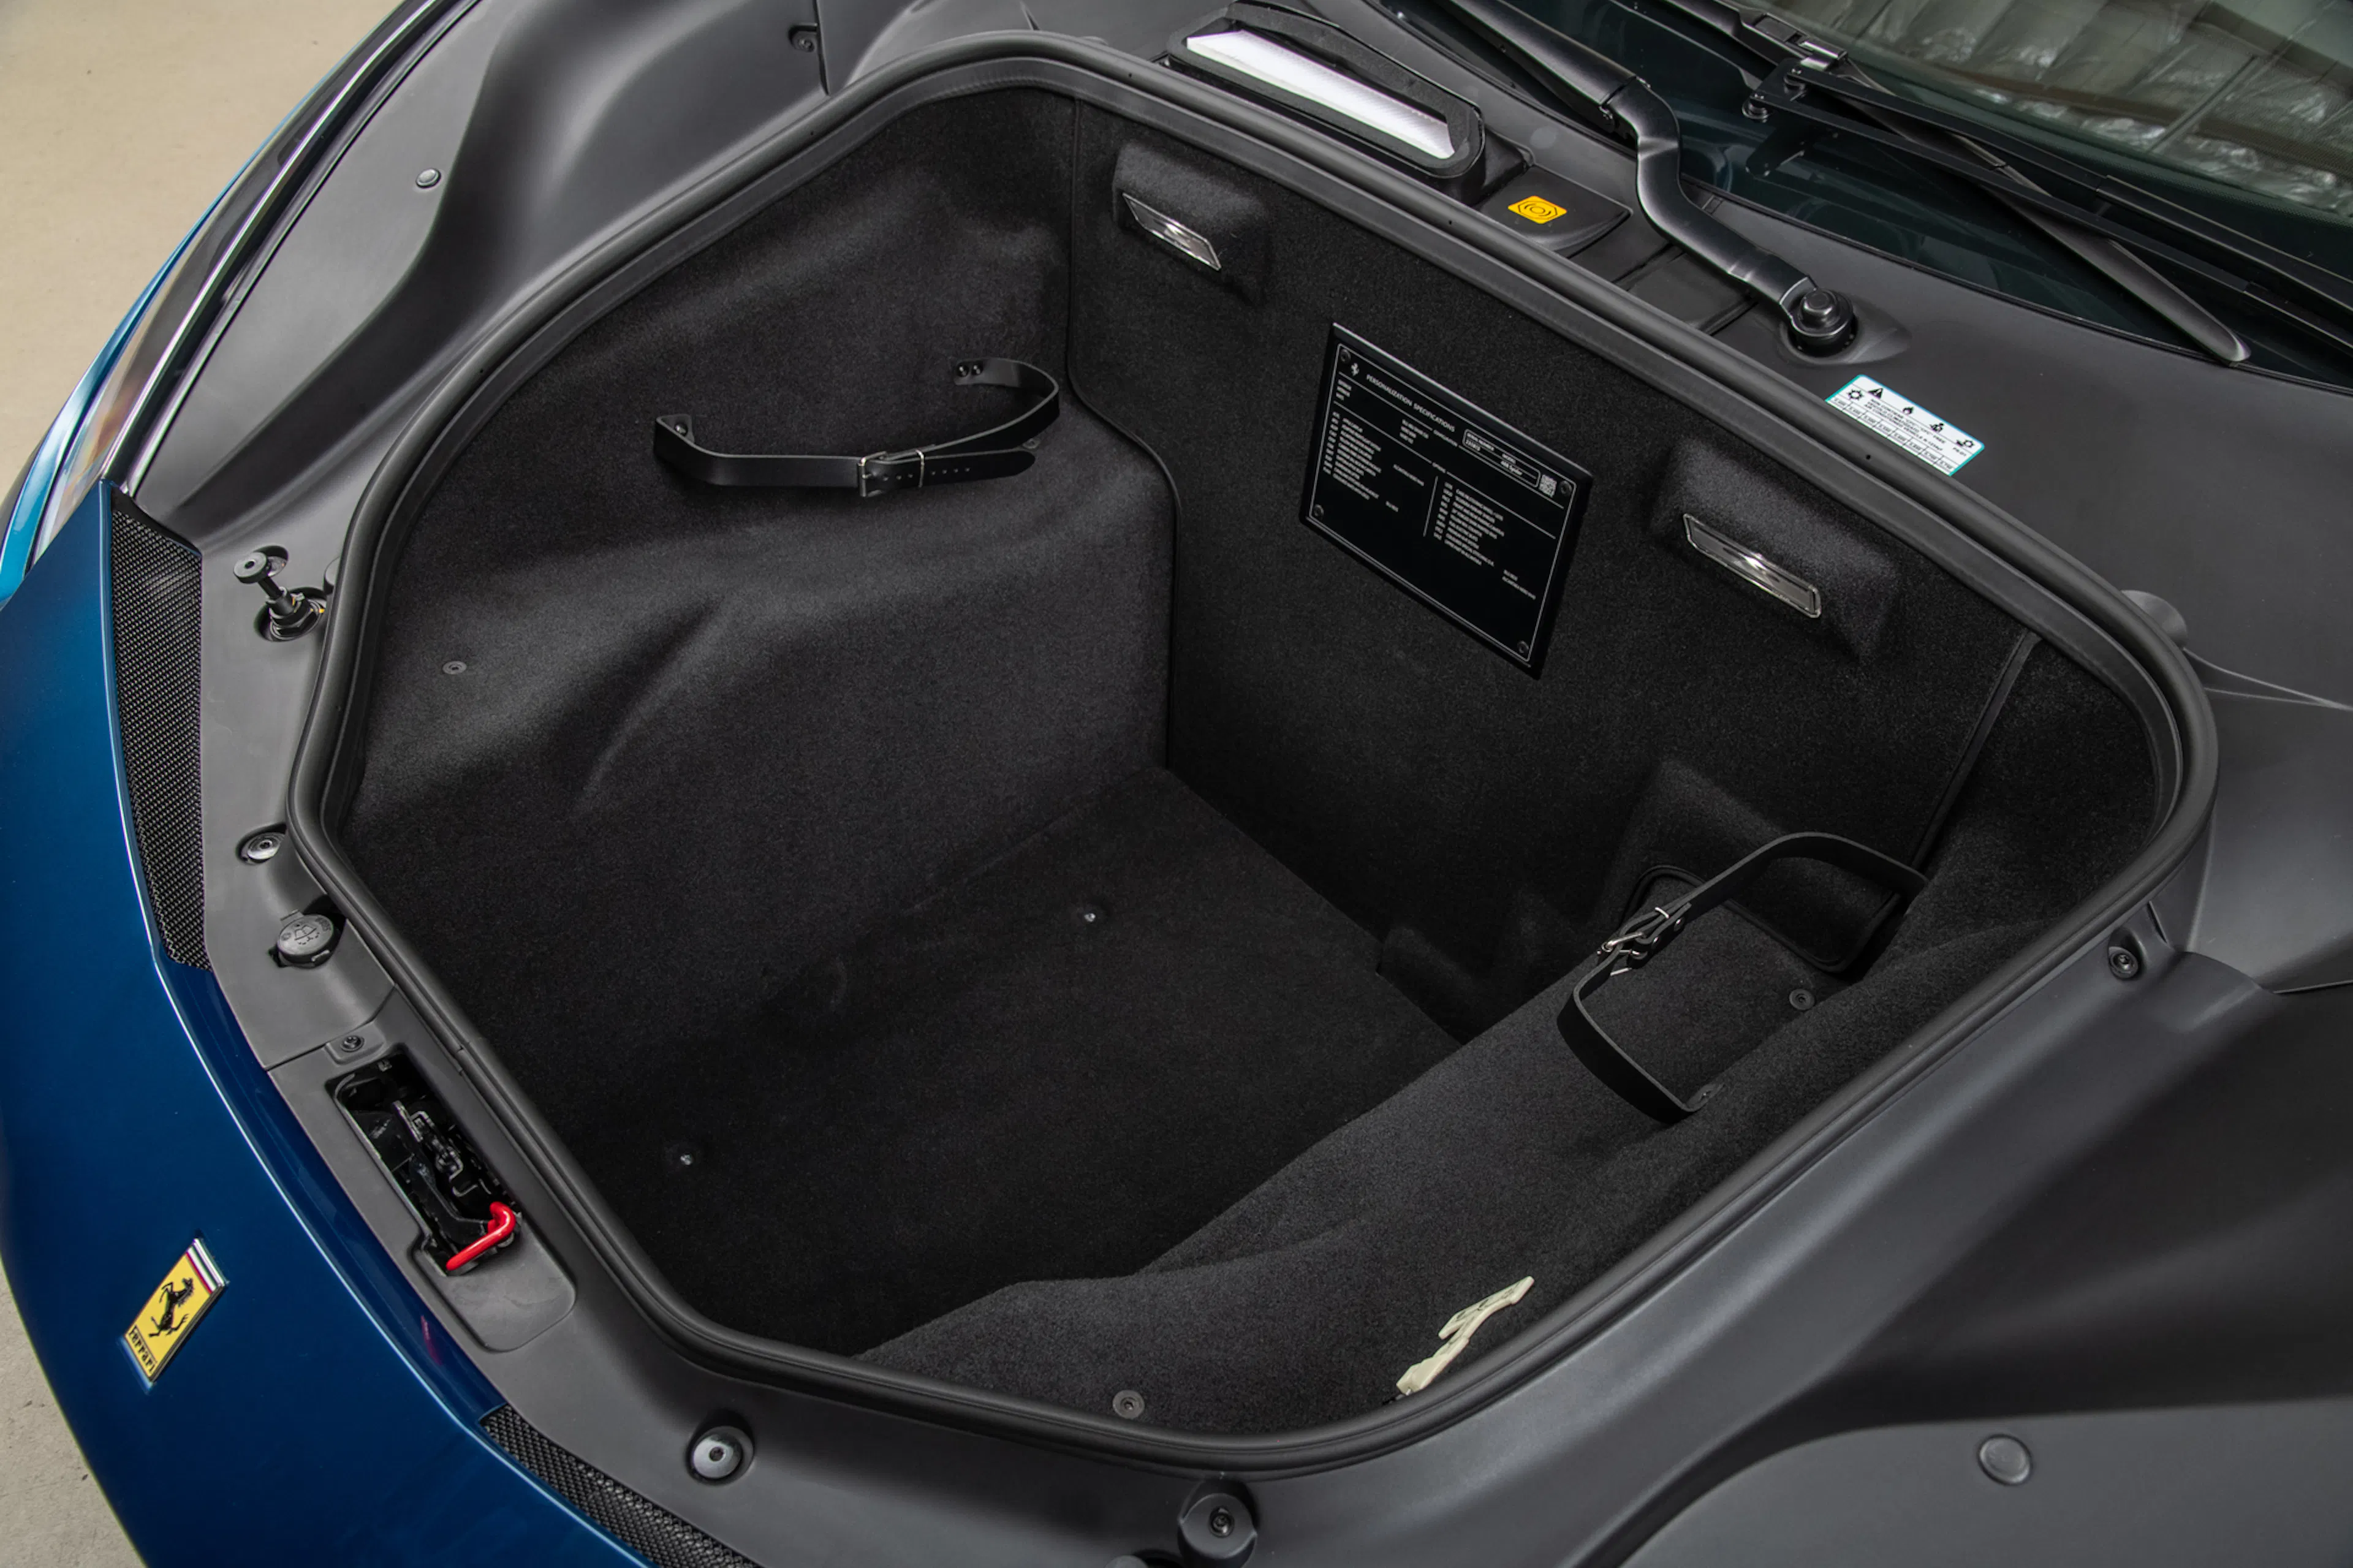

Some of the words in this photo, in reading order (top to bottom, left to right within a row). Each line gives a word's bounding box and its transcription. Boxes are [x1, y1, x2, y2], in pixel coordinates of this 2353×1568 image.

[1366, 374, 1412, 407] PERSONALIZATION
[1413, 403, 1455, 433] SPECIFICATIONS
[129, 1325, 157, 1372] Ferrari
